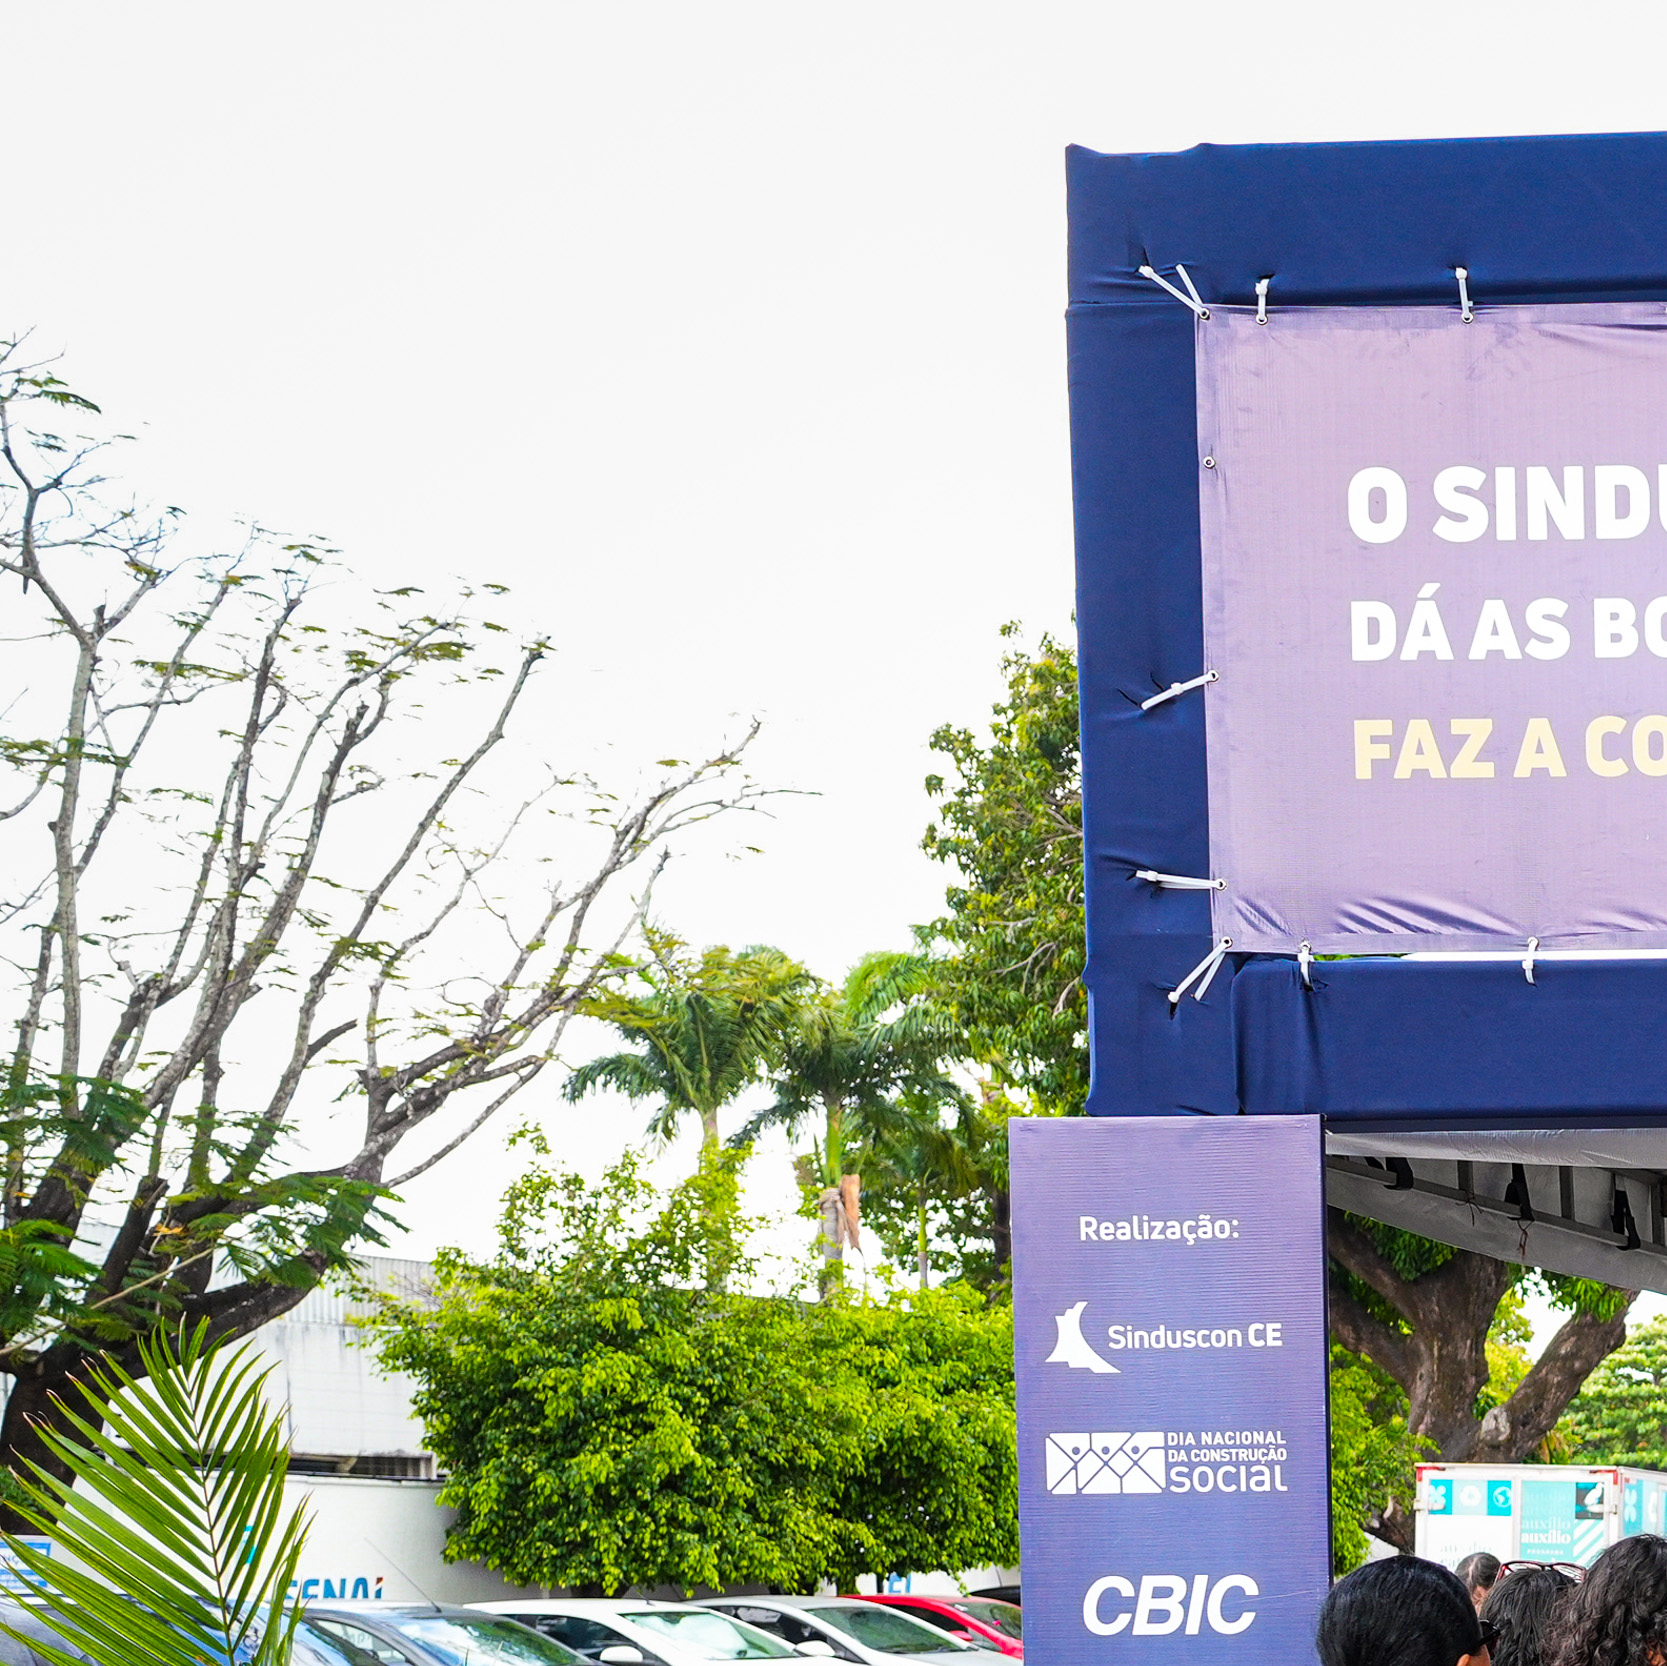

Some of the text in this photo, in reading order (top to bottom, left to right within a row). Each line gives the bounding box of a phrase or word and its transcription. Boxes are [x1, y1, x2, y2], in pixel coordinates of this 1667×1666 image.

[1348, 466, 1407, 544] O
[1350, 582, 1453, 662] DÁ
[1468, 596, 1569, 661] AS
[1353, 716, 1496, 780] FAZ
[1512, 716, 1567, 778] A
[1079, 1214, 1239, 1245] Realização:
[1108, 1323, 1283, 1349] Sinduscon CE
[1168, 1431, 1287, 1446] DIA NACIONAL
[1168, 1445, 1287, 1464] DA CONSTRUÇÃO
[1083, 1574, 1259, 1636] CBIC
